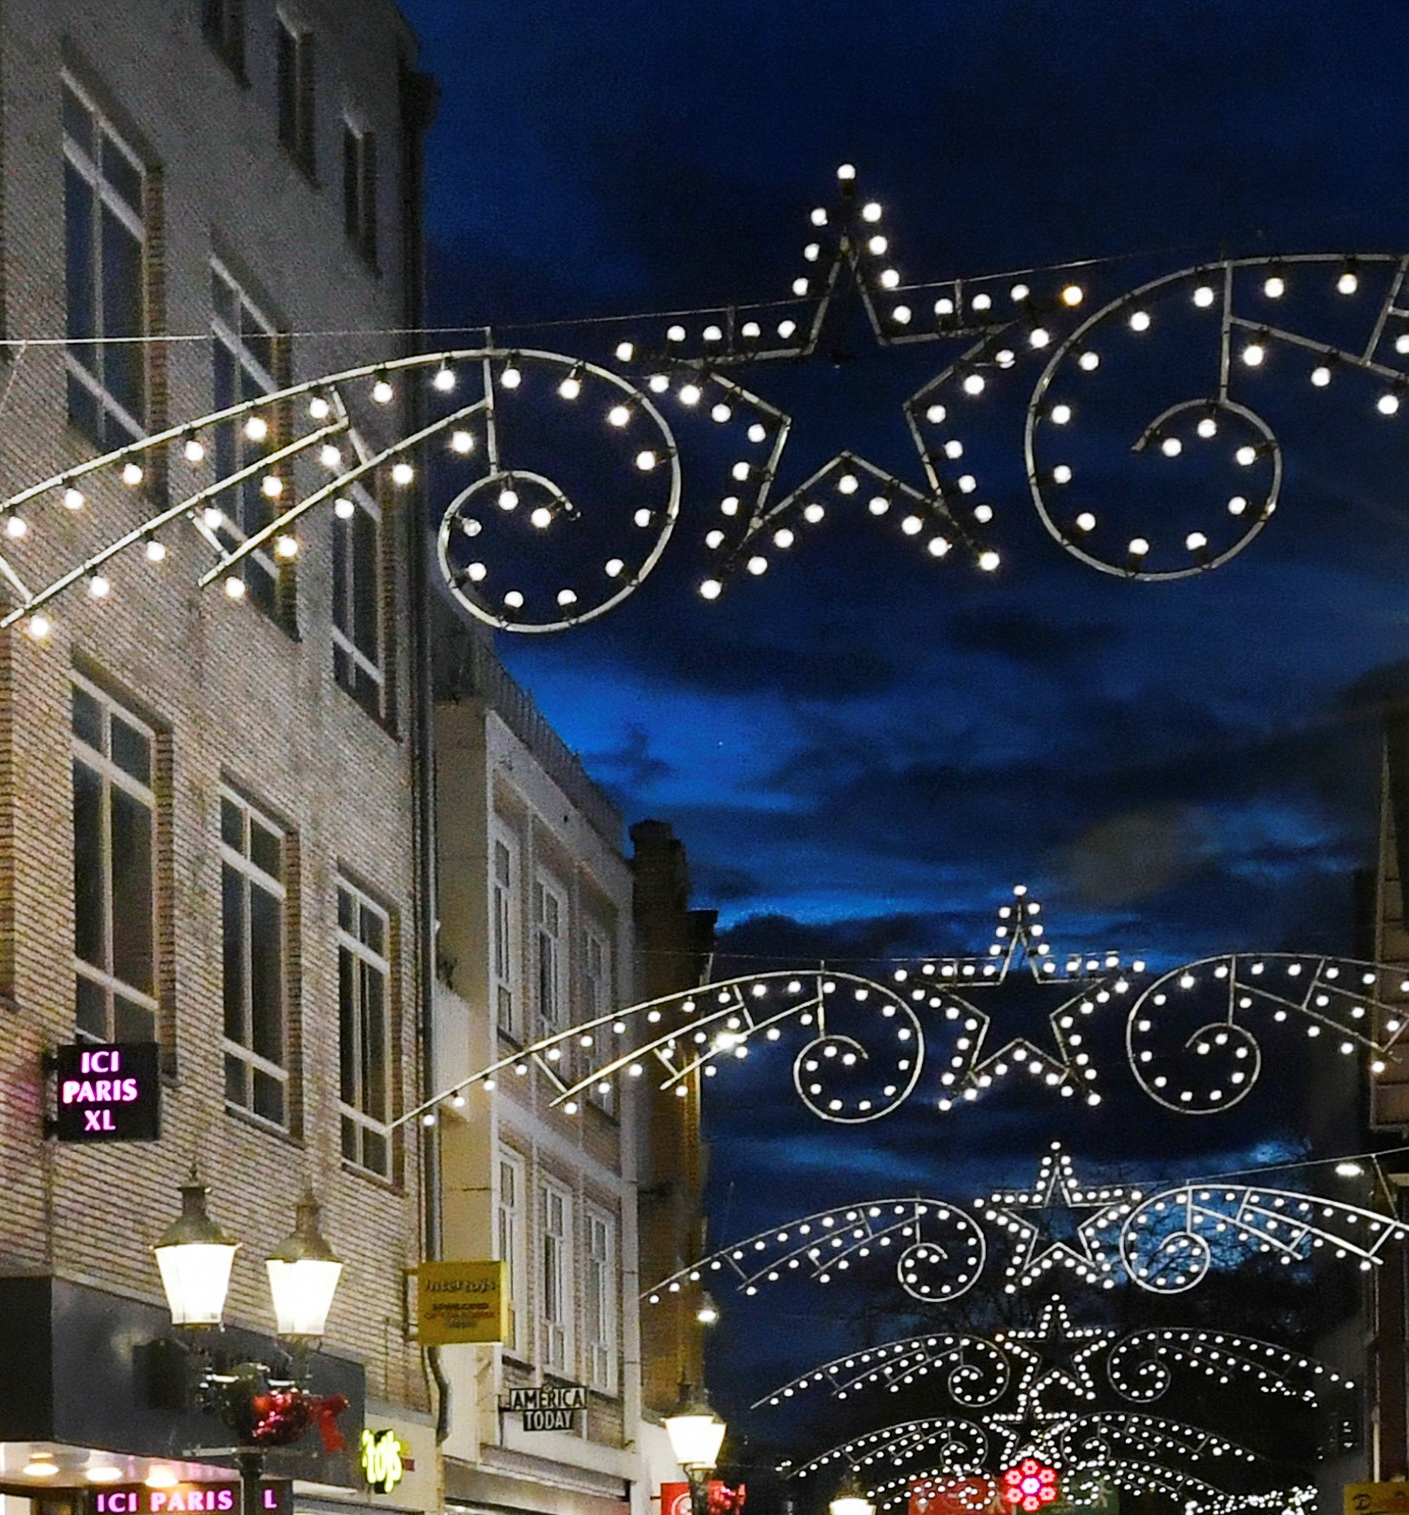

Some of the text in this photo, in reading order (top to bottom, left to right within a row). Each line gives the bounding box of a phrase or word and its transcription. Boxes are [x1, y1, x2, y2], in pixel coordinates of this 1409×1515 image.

[81, 1050, 120, 1074] ICI
[63, 1078, 138, 1104] PARIS
[84, 1109, 117, 1131] XL
[513, 1388, 584, 1410] AMERICA
[524, 1410, 573, 1430] TODAY
[96, 1493, 138, 1513] ICI
[150, 1490, 234, 1512] PARIS
